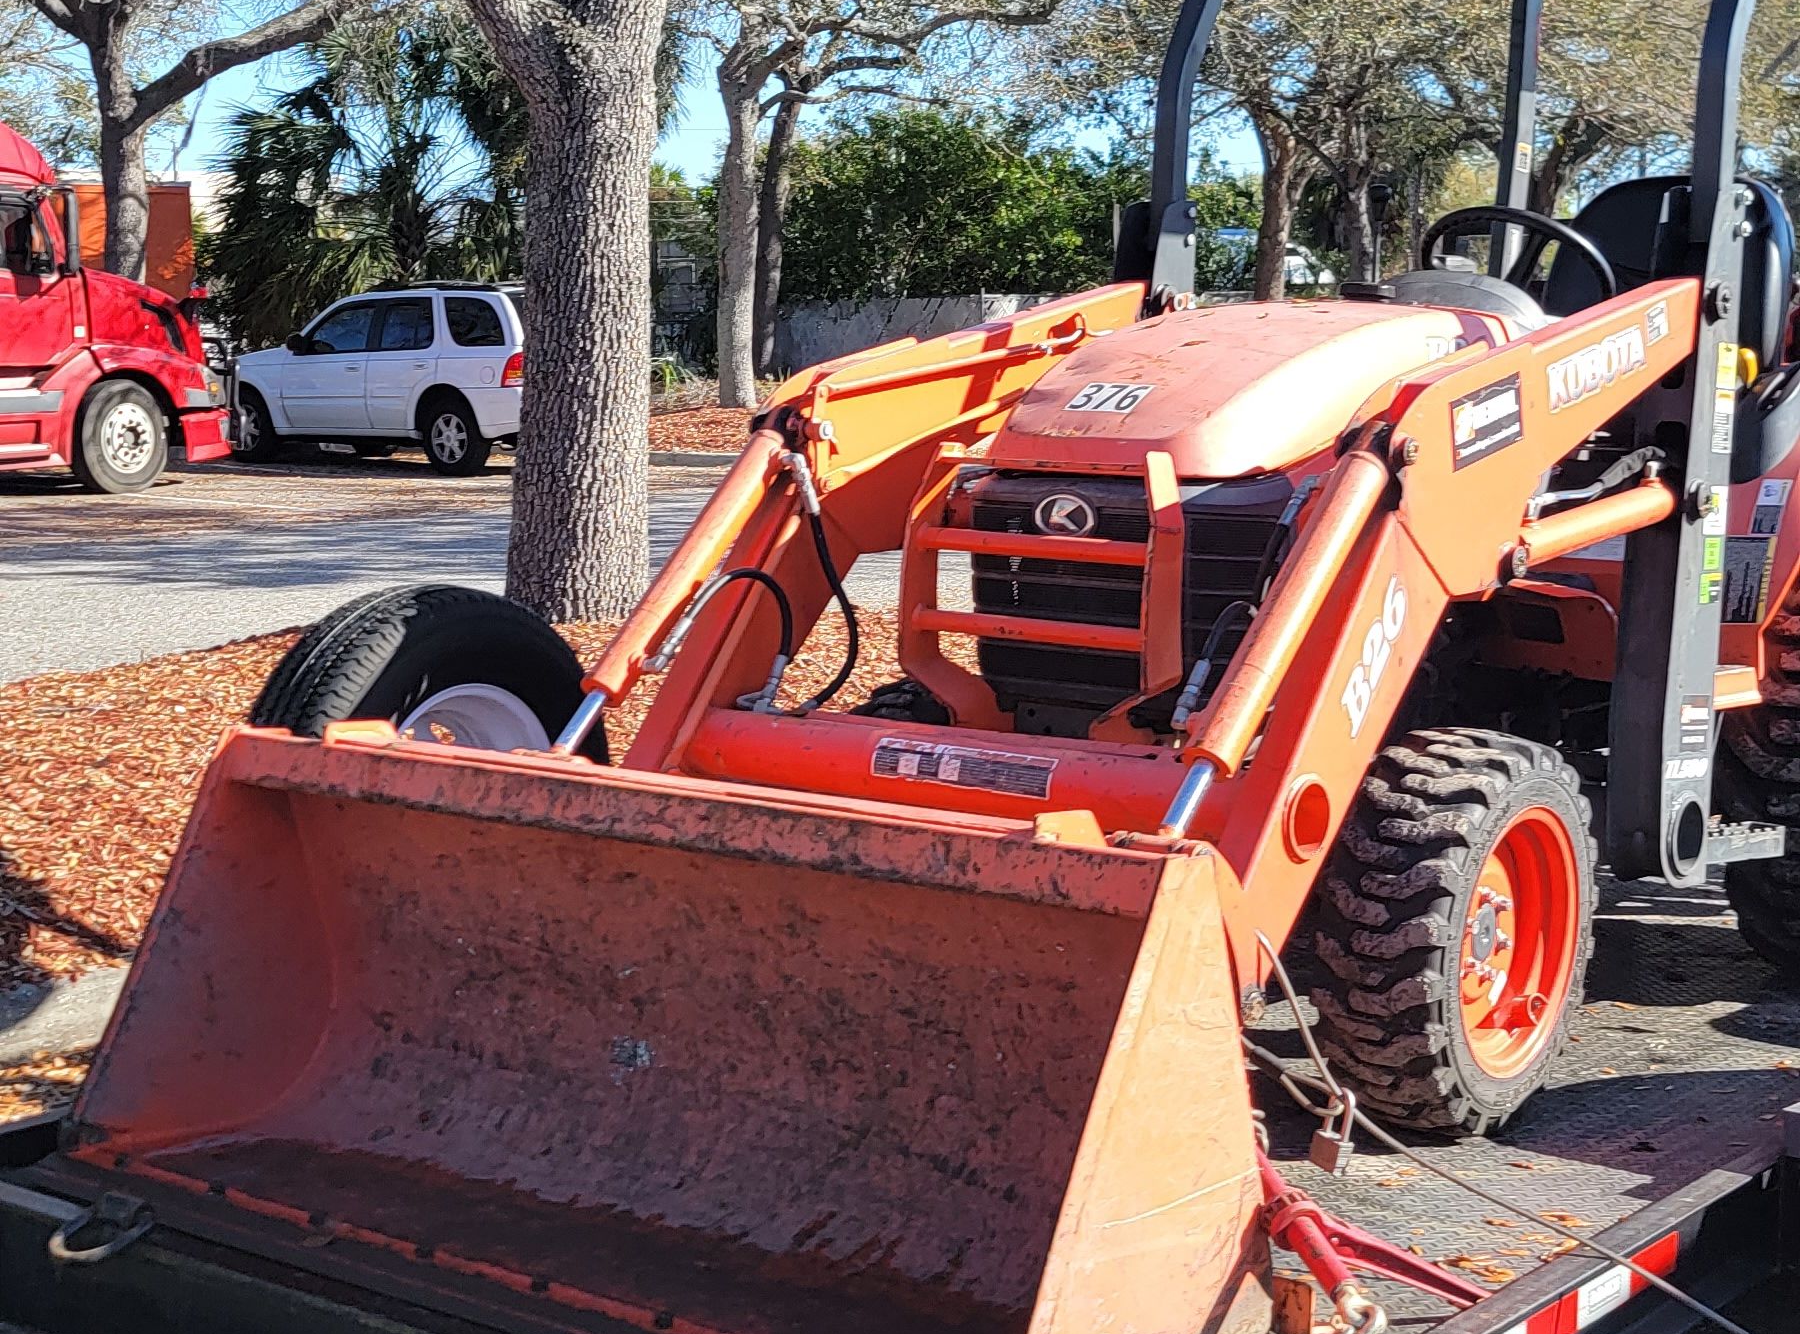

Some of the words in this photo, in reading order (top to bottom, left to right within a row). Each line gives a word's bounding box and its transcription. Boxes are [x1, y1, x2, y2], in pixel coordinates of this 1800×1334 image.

[1067, 384, 1151, 411] 376
[1547, 327, 1649, 413] KUBOTA
[1341, 575, 1408, 739] B26
